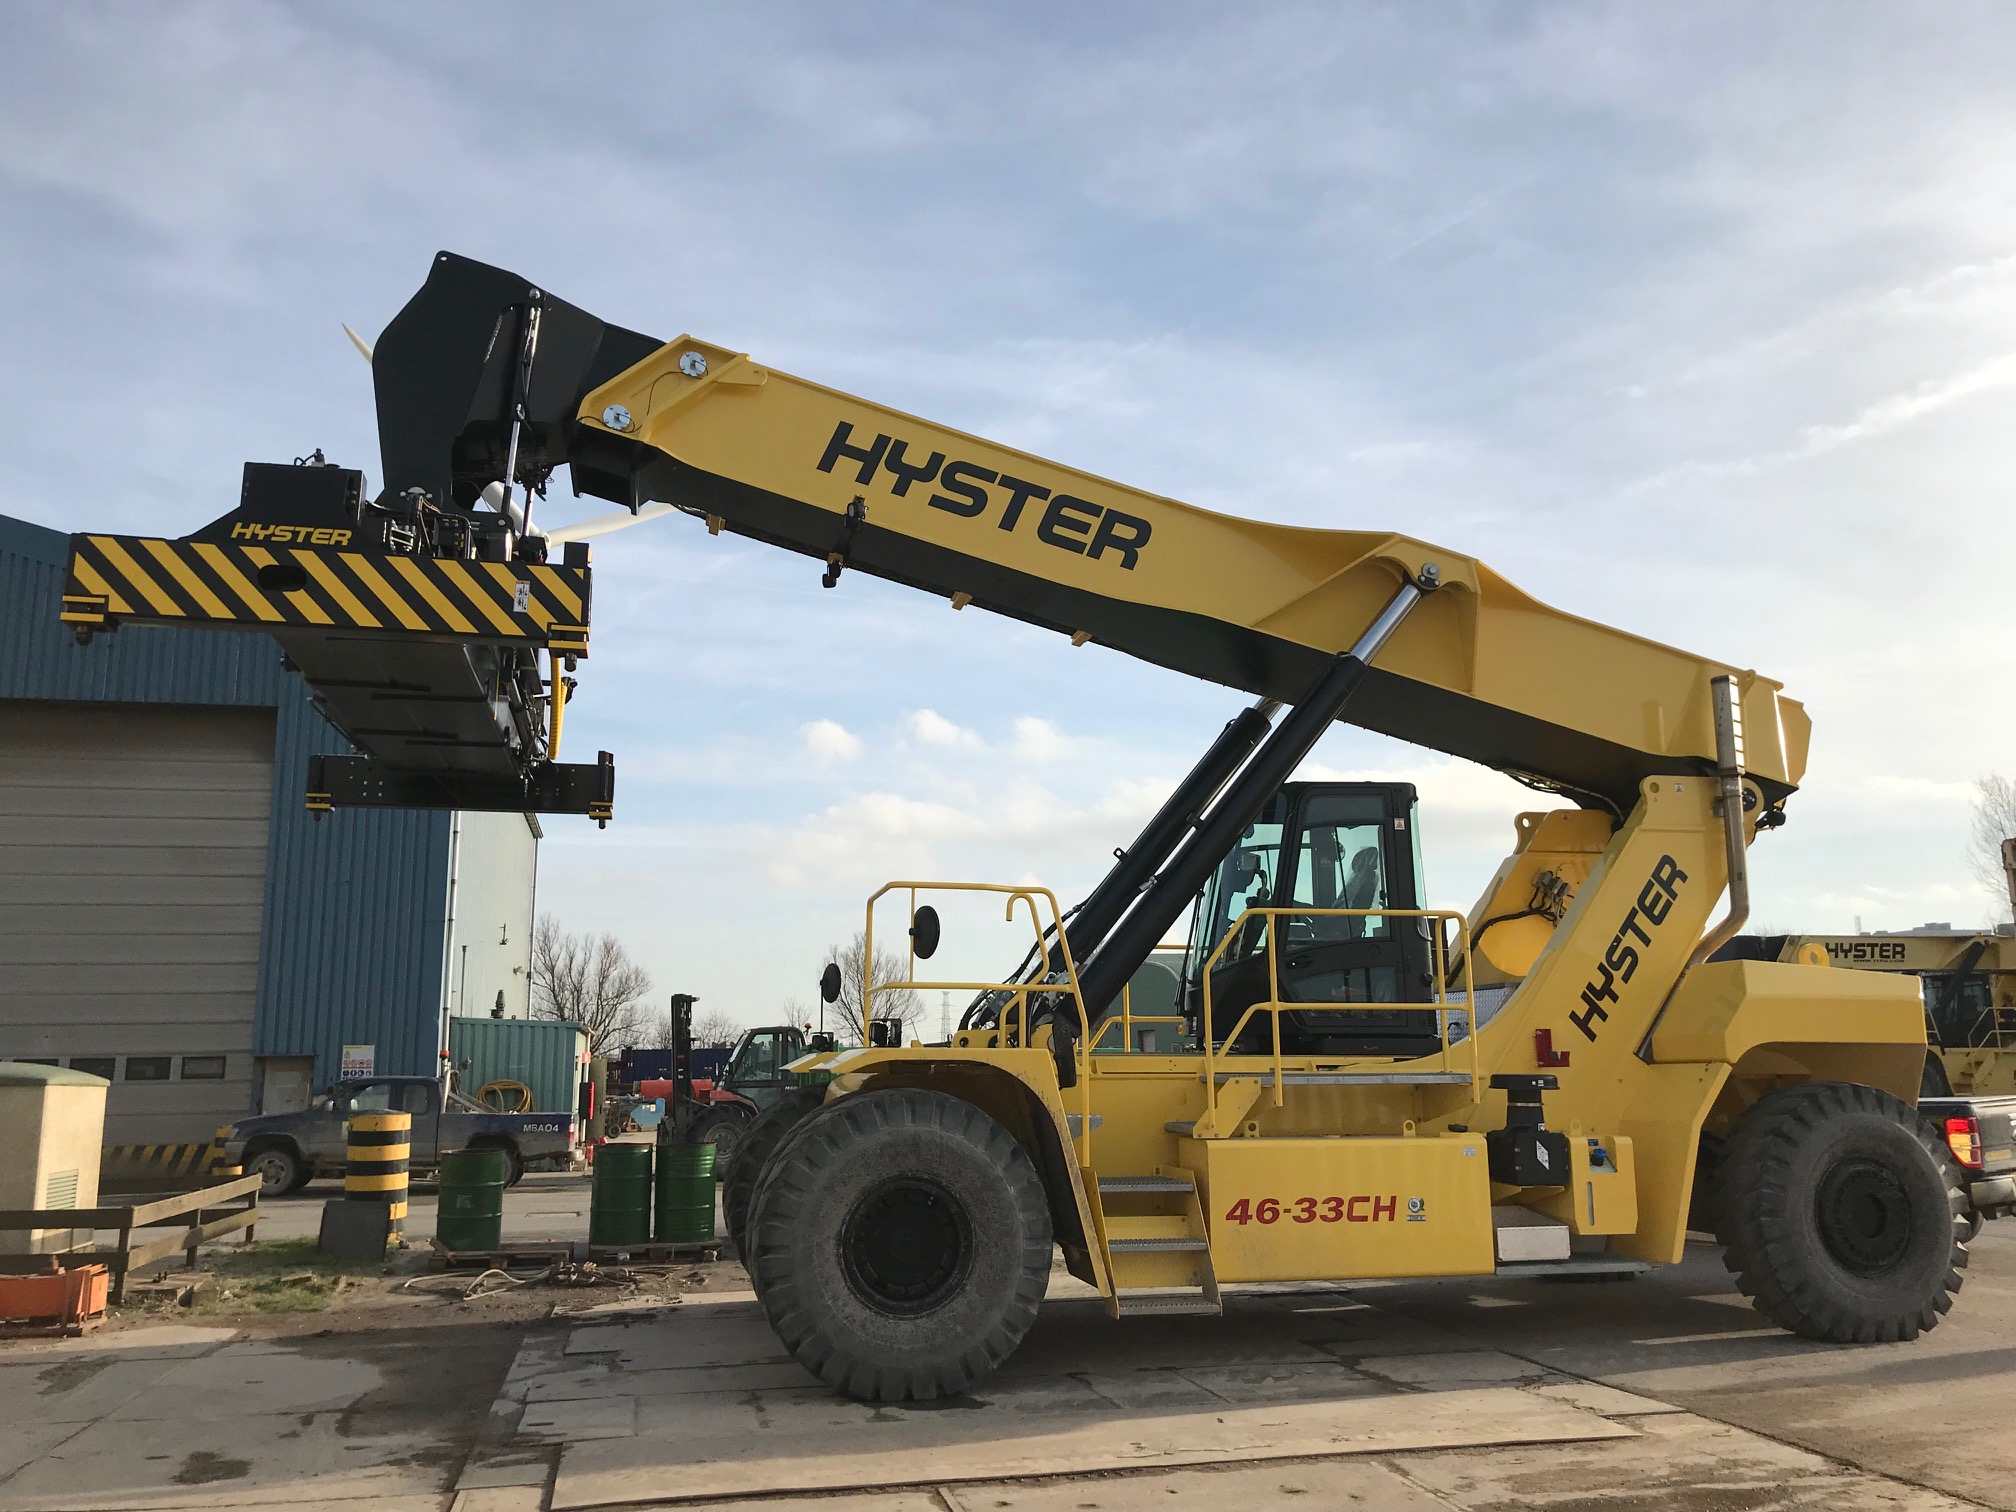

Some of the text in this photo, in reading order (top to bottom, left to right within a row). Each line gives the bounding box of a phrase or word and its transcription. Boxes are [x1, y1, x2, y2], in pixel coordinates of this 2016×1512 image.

[816, 420, 1153, 571] HYSTER
[230, 522, 353, 546] HYSTER
[1568, 854, 1689, 1043] HYSTER
[1825, 942, 1906, 959] HYSTER
[1225, 1195, 1398, 1226] 46-33CH
